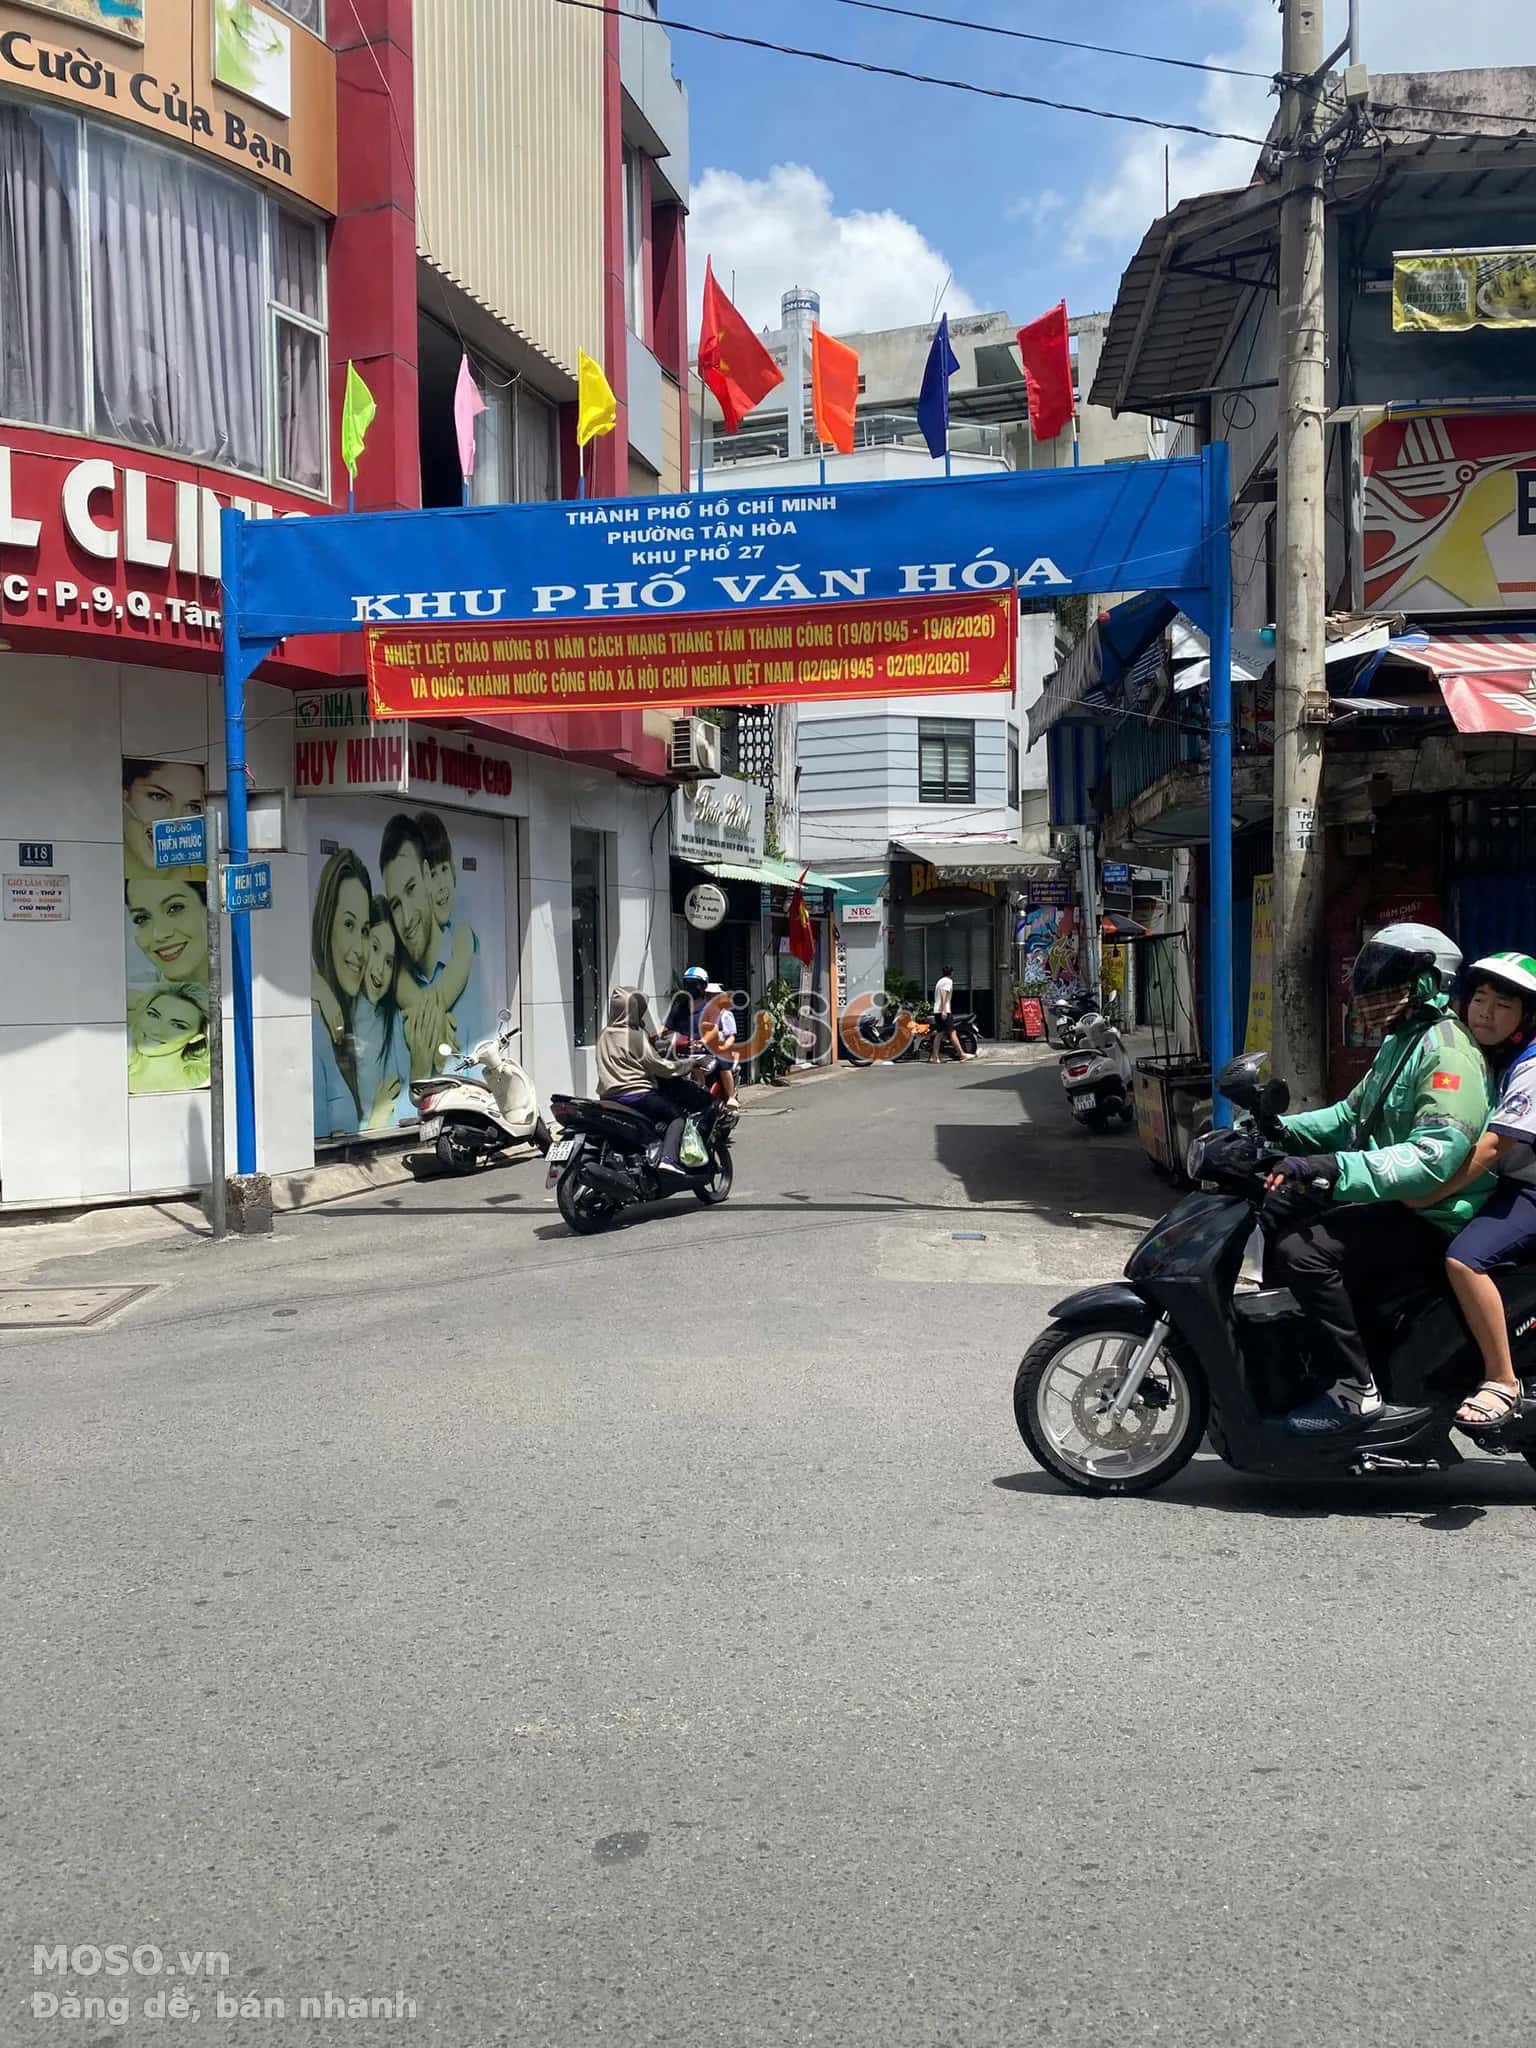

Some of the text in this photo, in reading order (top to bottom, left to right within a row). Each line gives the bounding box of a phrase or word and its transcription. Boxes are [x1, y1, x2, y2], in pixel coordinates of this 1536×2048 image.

[0, 31, 292, 176] Cười Của Bạn
[566, 496, 837, 525] THÀNH PHỐ HỒ CHÍ MINH
[608, 518, 797, 545] PHƯỜNG TÂN HÒA
[632, 541, 765, 566] KHU PHỐ 27
[351, 546, 1072, 622] KHU PHỐ VĂN HÓA
[384, 641, 422, 673] NHIỆT
[425, 640, 451, 669] LIỆT
[455, 637, 489, 663] CHÀO
[492, 636, 532, 662] MỪNG
[535, 639, 550, 660] 81
[554, 637, 584, 659] NĂM
[588, 633, 624, 658] CÁCH
[627, 633, 666, 660] MẠNG
[670, 630, 713, 653] THÁNG
[717, 624, 744, 652] TÁM
[749, 623, 793, 649] THÀNH
[797, 621, 833, 647] CÔNG
[838, 620, 909, 649] (19/8/1945
[922, 614, 996, 642] 19/8/2026)
[411, 675, 428, 699] VÀ
[431, 670, 465, 699] QUỐC
[467, 671, 511, 696] KHÁNH
[513, 669, 547, 695] NƯỚC
[551, 669, 585, 697] CỘNG
[588, 664, 613, 691] HÒA
[617, 664, 634, 689] XÃ
[638, 666, 659, 694] HỘI
[662, 661, 688, 689] CHỦ
[691, 660, 730, 687] NGHĨA
[733, 660, 761, 690] VIỆT
[764, 661, 794, 683] NAM
[798, 656, 874, 684] (02/09/1945
[886, 651, 970, 678] 02/09/2026)!
[295, 740, 338, 786] HUY
[346, 735, 403, 784] MINH
[25, 846, 48, 859] 118
[851, 906, 872, 916] NEC
